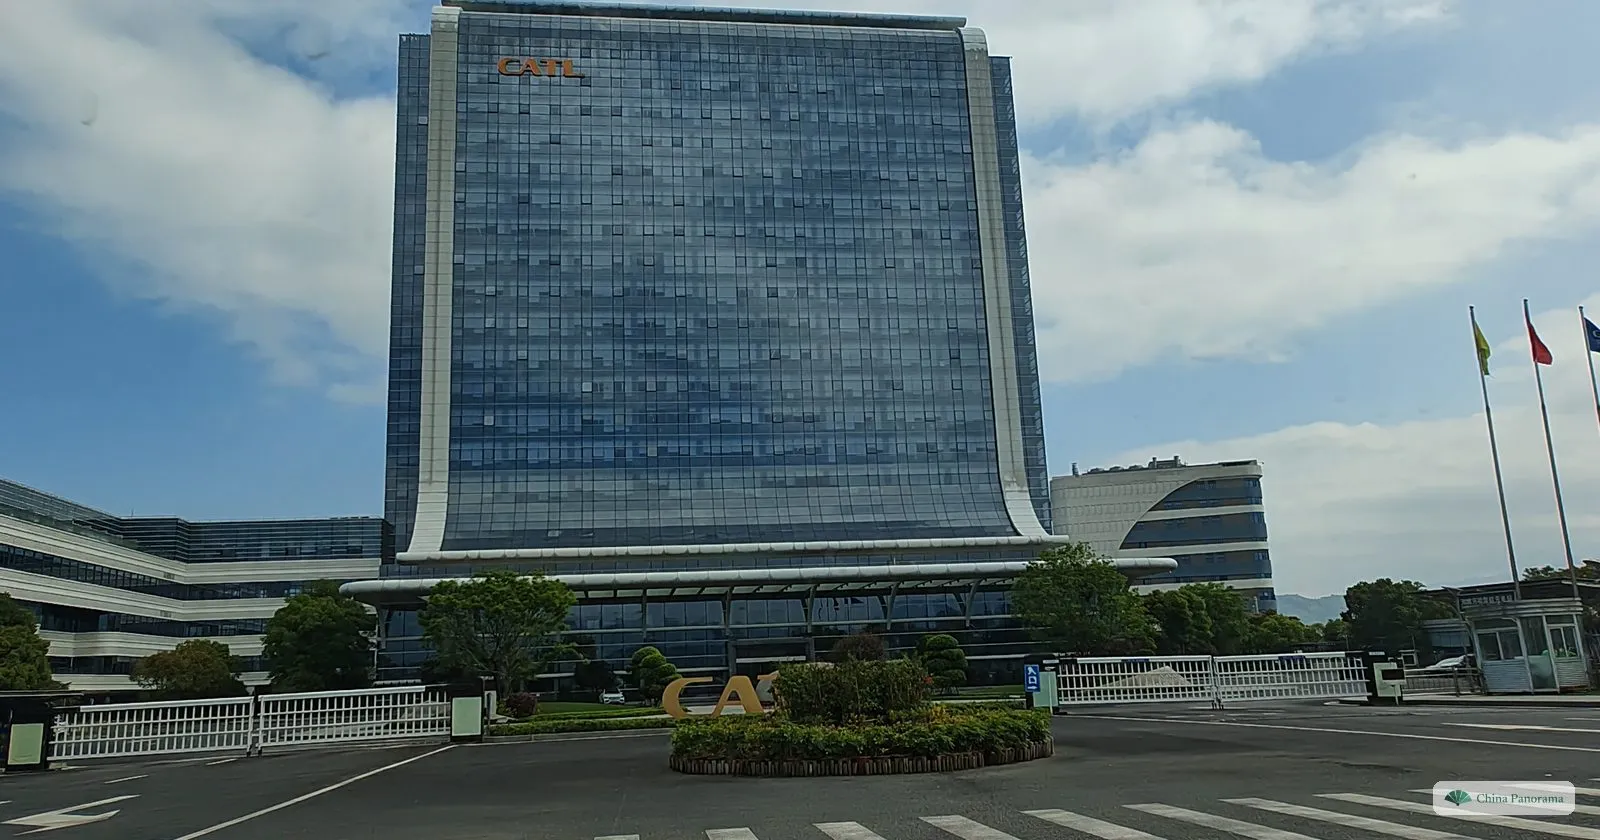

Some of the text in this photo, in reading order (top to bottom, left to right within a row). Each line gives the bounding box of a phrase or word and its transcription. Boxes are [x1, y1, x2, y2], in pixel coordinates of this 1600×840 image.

[497, 57, 585, 78] CATL
[1027, 666, 1038, 685] 入口
[662, 671, 779, 719] CA
